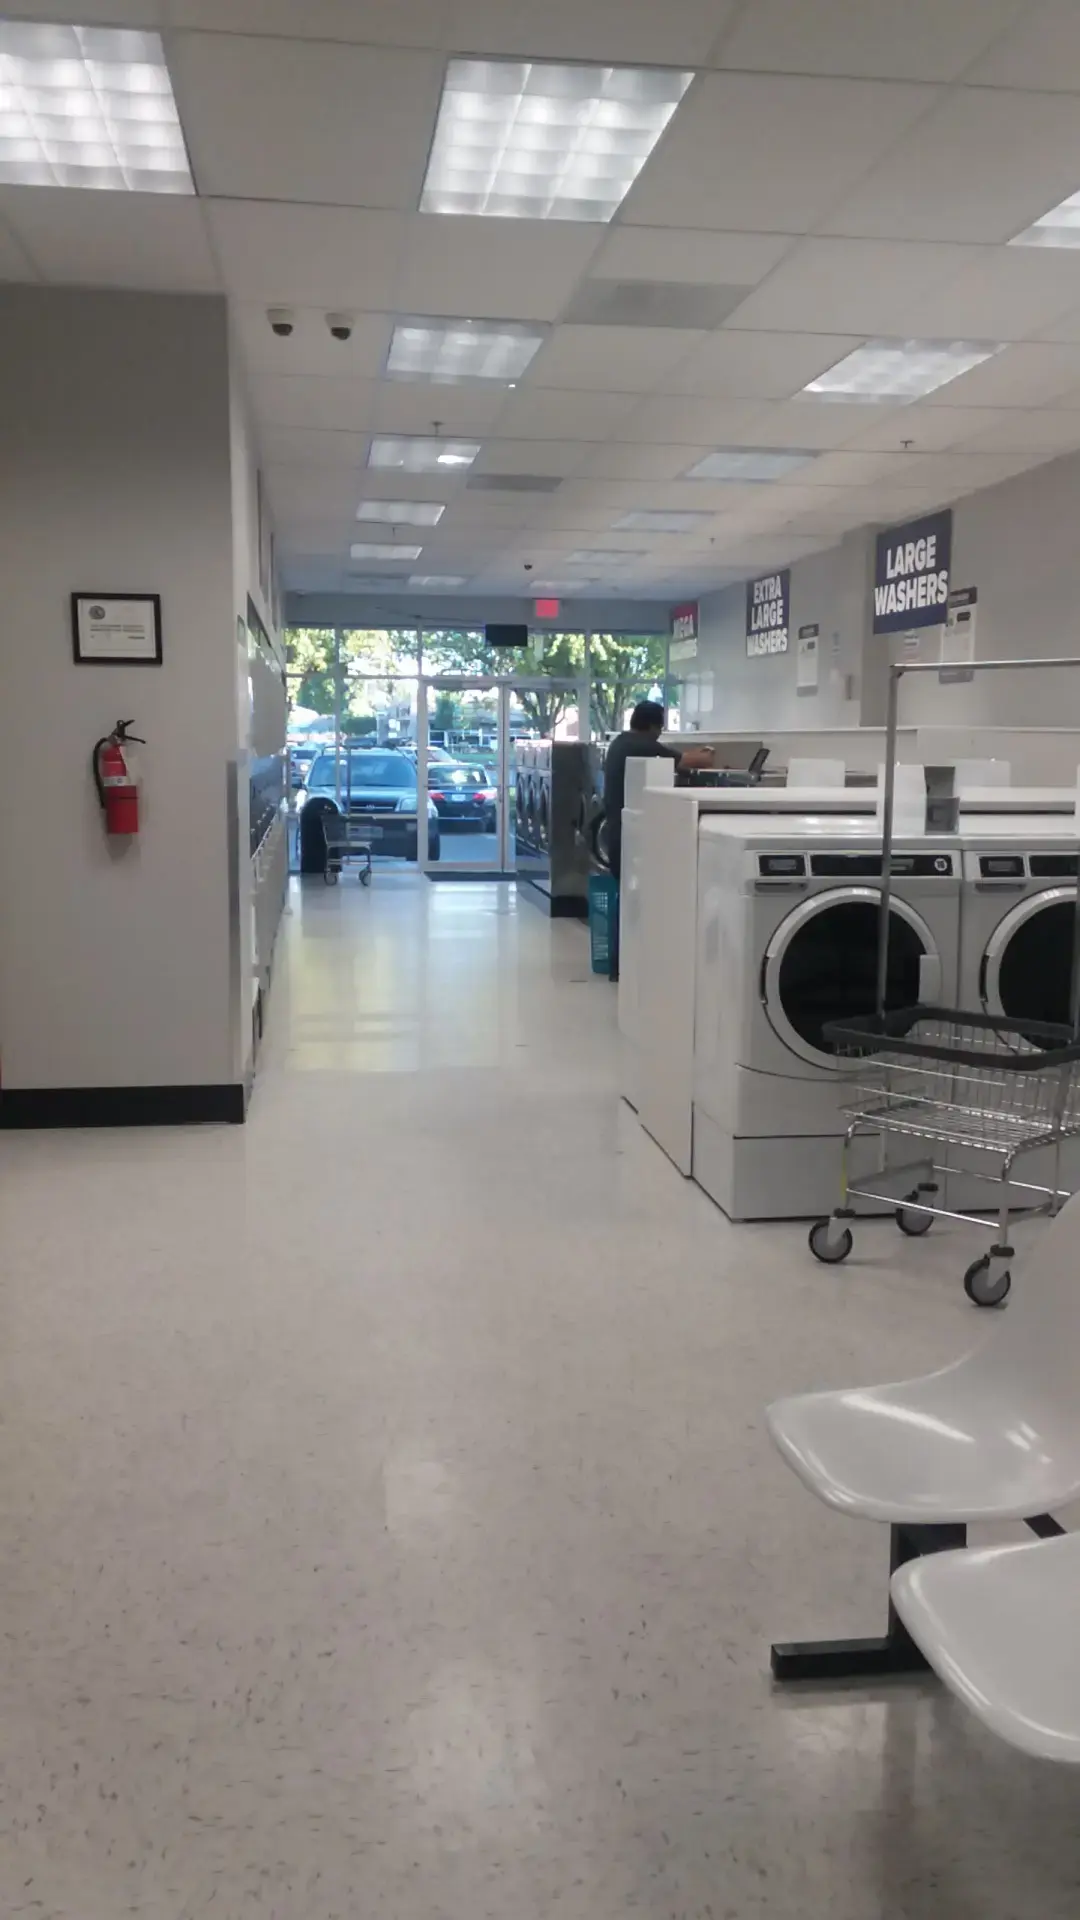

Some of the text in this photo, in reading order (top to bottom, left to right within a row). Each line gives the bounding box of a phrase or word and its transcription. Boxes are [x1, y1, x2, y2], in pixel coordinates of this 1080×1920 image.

[886, 534, 937, 579] LARGE
[753, 575, 783, 604] EXTRA
[874, 569, 949, 616] WASHERS
[751, 599, 784, 631] LARGE
